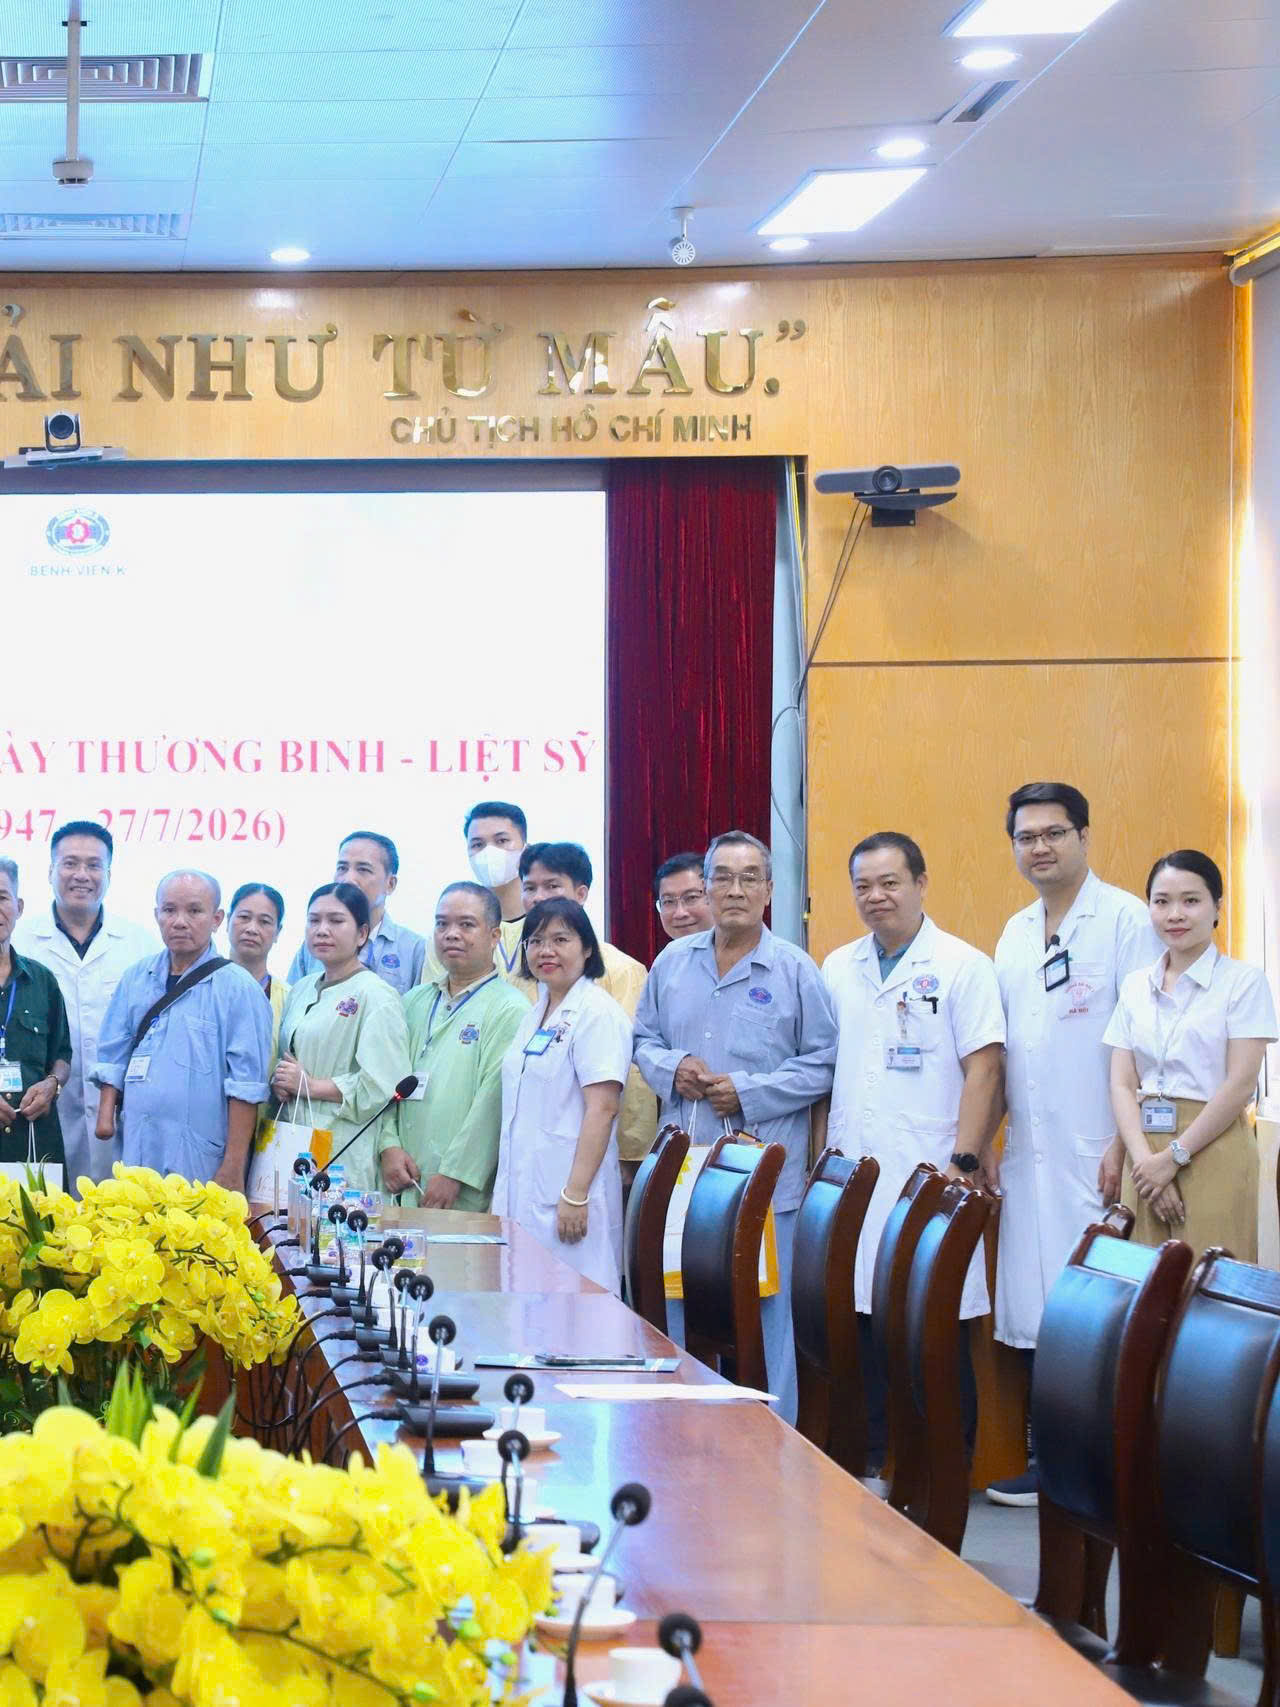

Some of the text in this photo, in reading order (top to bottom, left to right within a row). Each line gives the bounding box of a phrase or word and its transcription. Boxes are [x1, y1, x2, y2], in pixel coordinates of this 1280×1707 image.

[112, 322, 339, 402] NHƯ
[372, 308, 505, 399] TỪ
[389, 403, 753, 449] CHỦ TỊCH HỒ CHÍ MINH
[68, 734, 264, 776] THƯƠNG
[280, 738, 386, 774] BINH
[428, 733, 531, 783] LIỆT
[543, 730, 596, 775] SỸ
